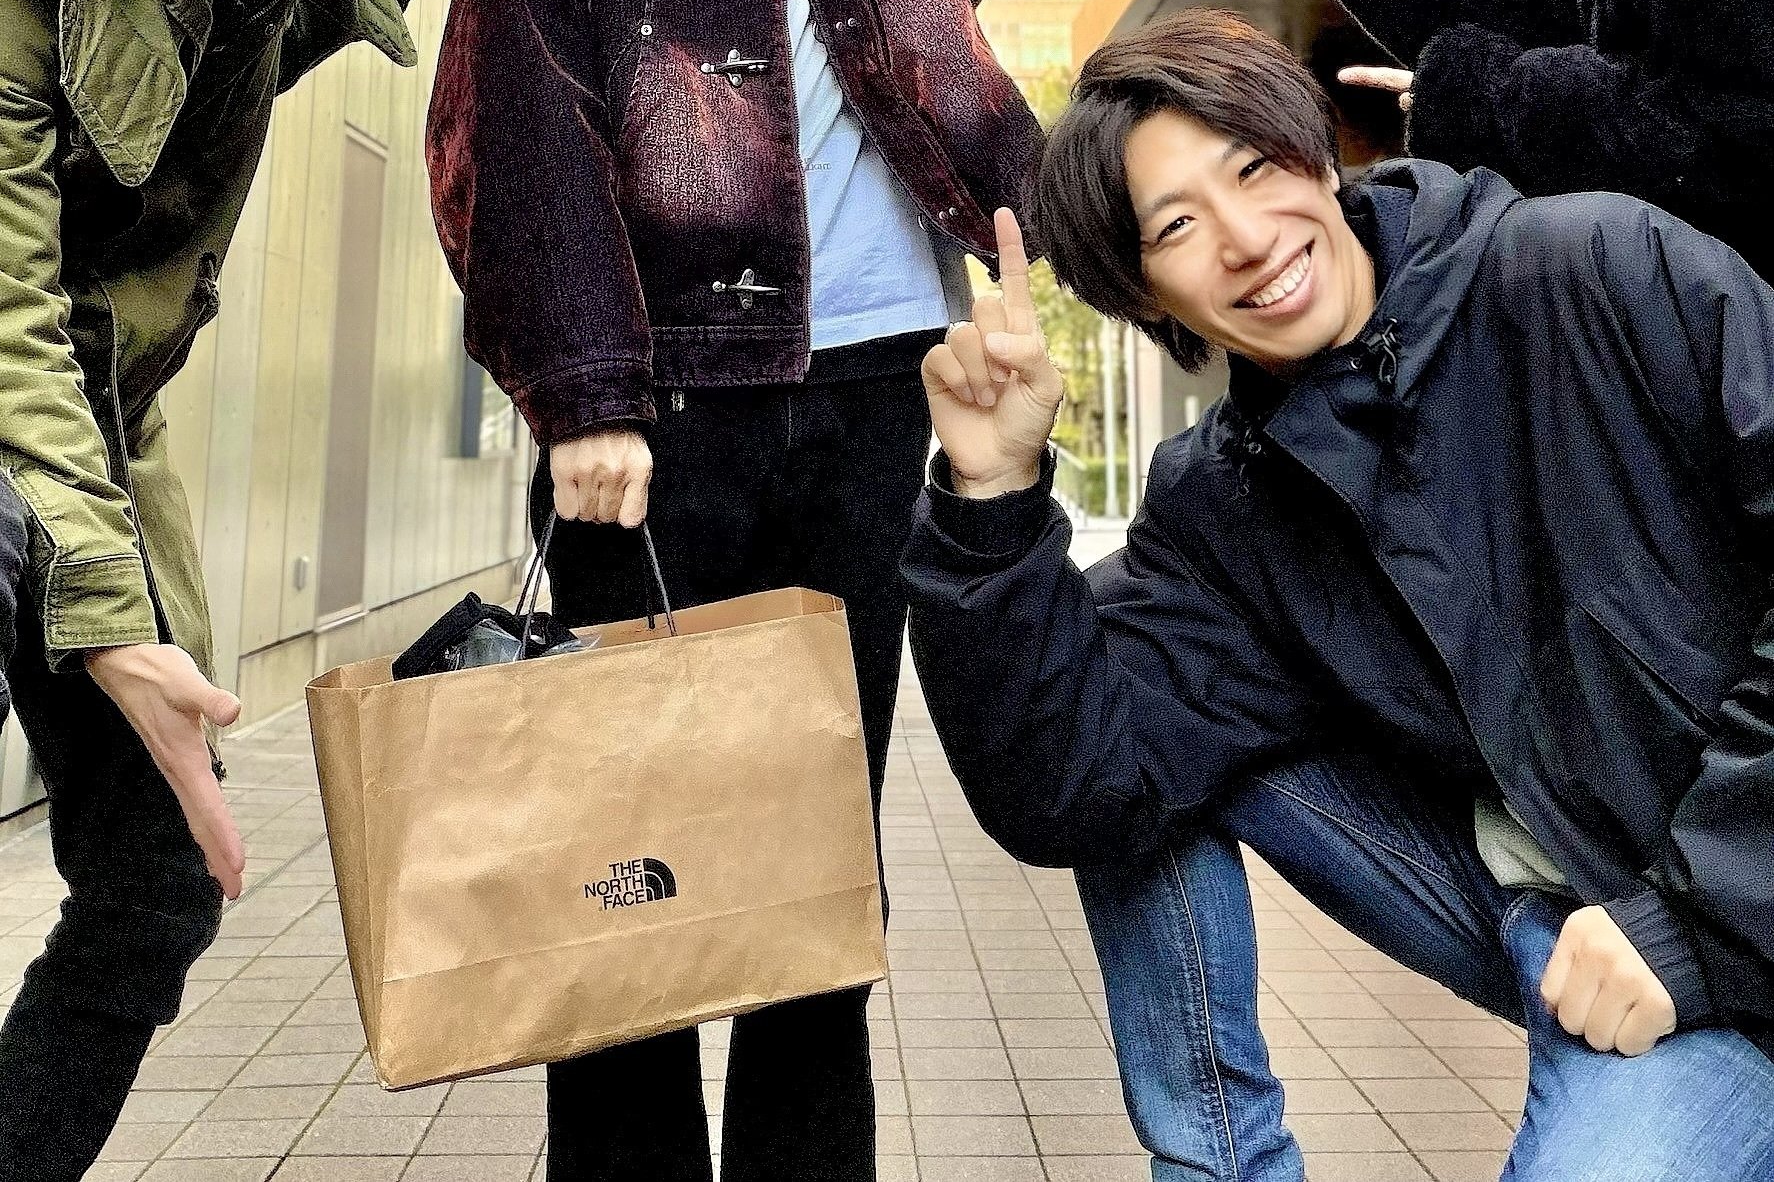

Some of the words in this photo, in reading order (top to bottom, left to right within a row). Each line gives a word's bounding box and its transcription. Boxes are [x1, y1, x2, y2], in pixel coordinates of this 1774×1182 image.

[608, 859, 642, 877] THE
[584, 874, 643, 898] NORTH
[603, 889, 645, 910] FACE
